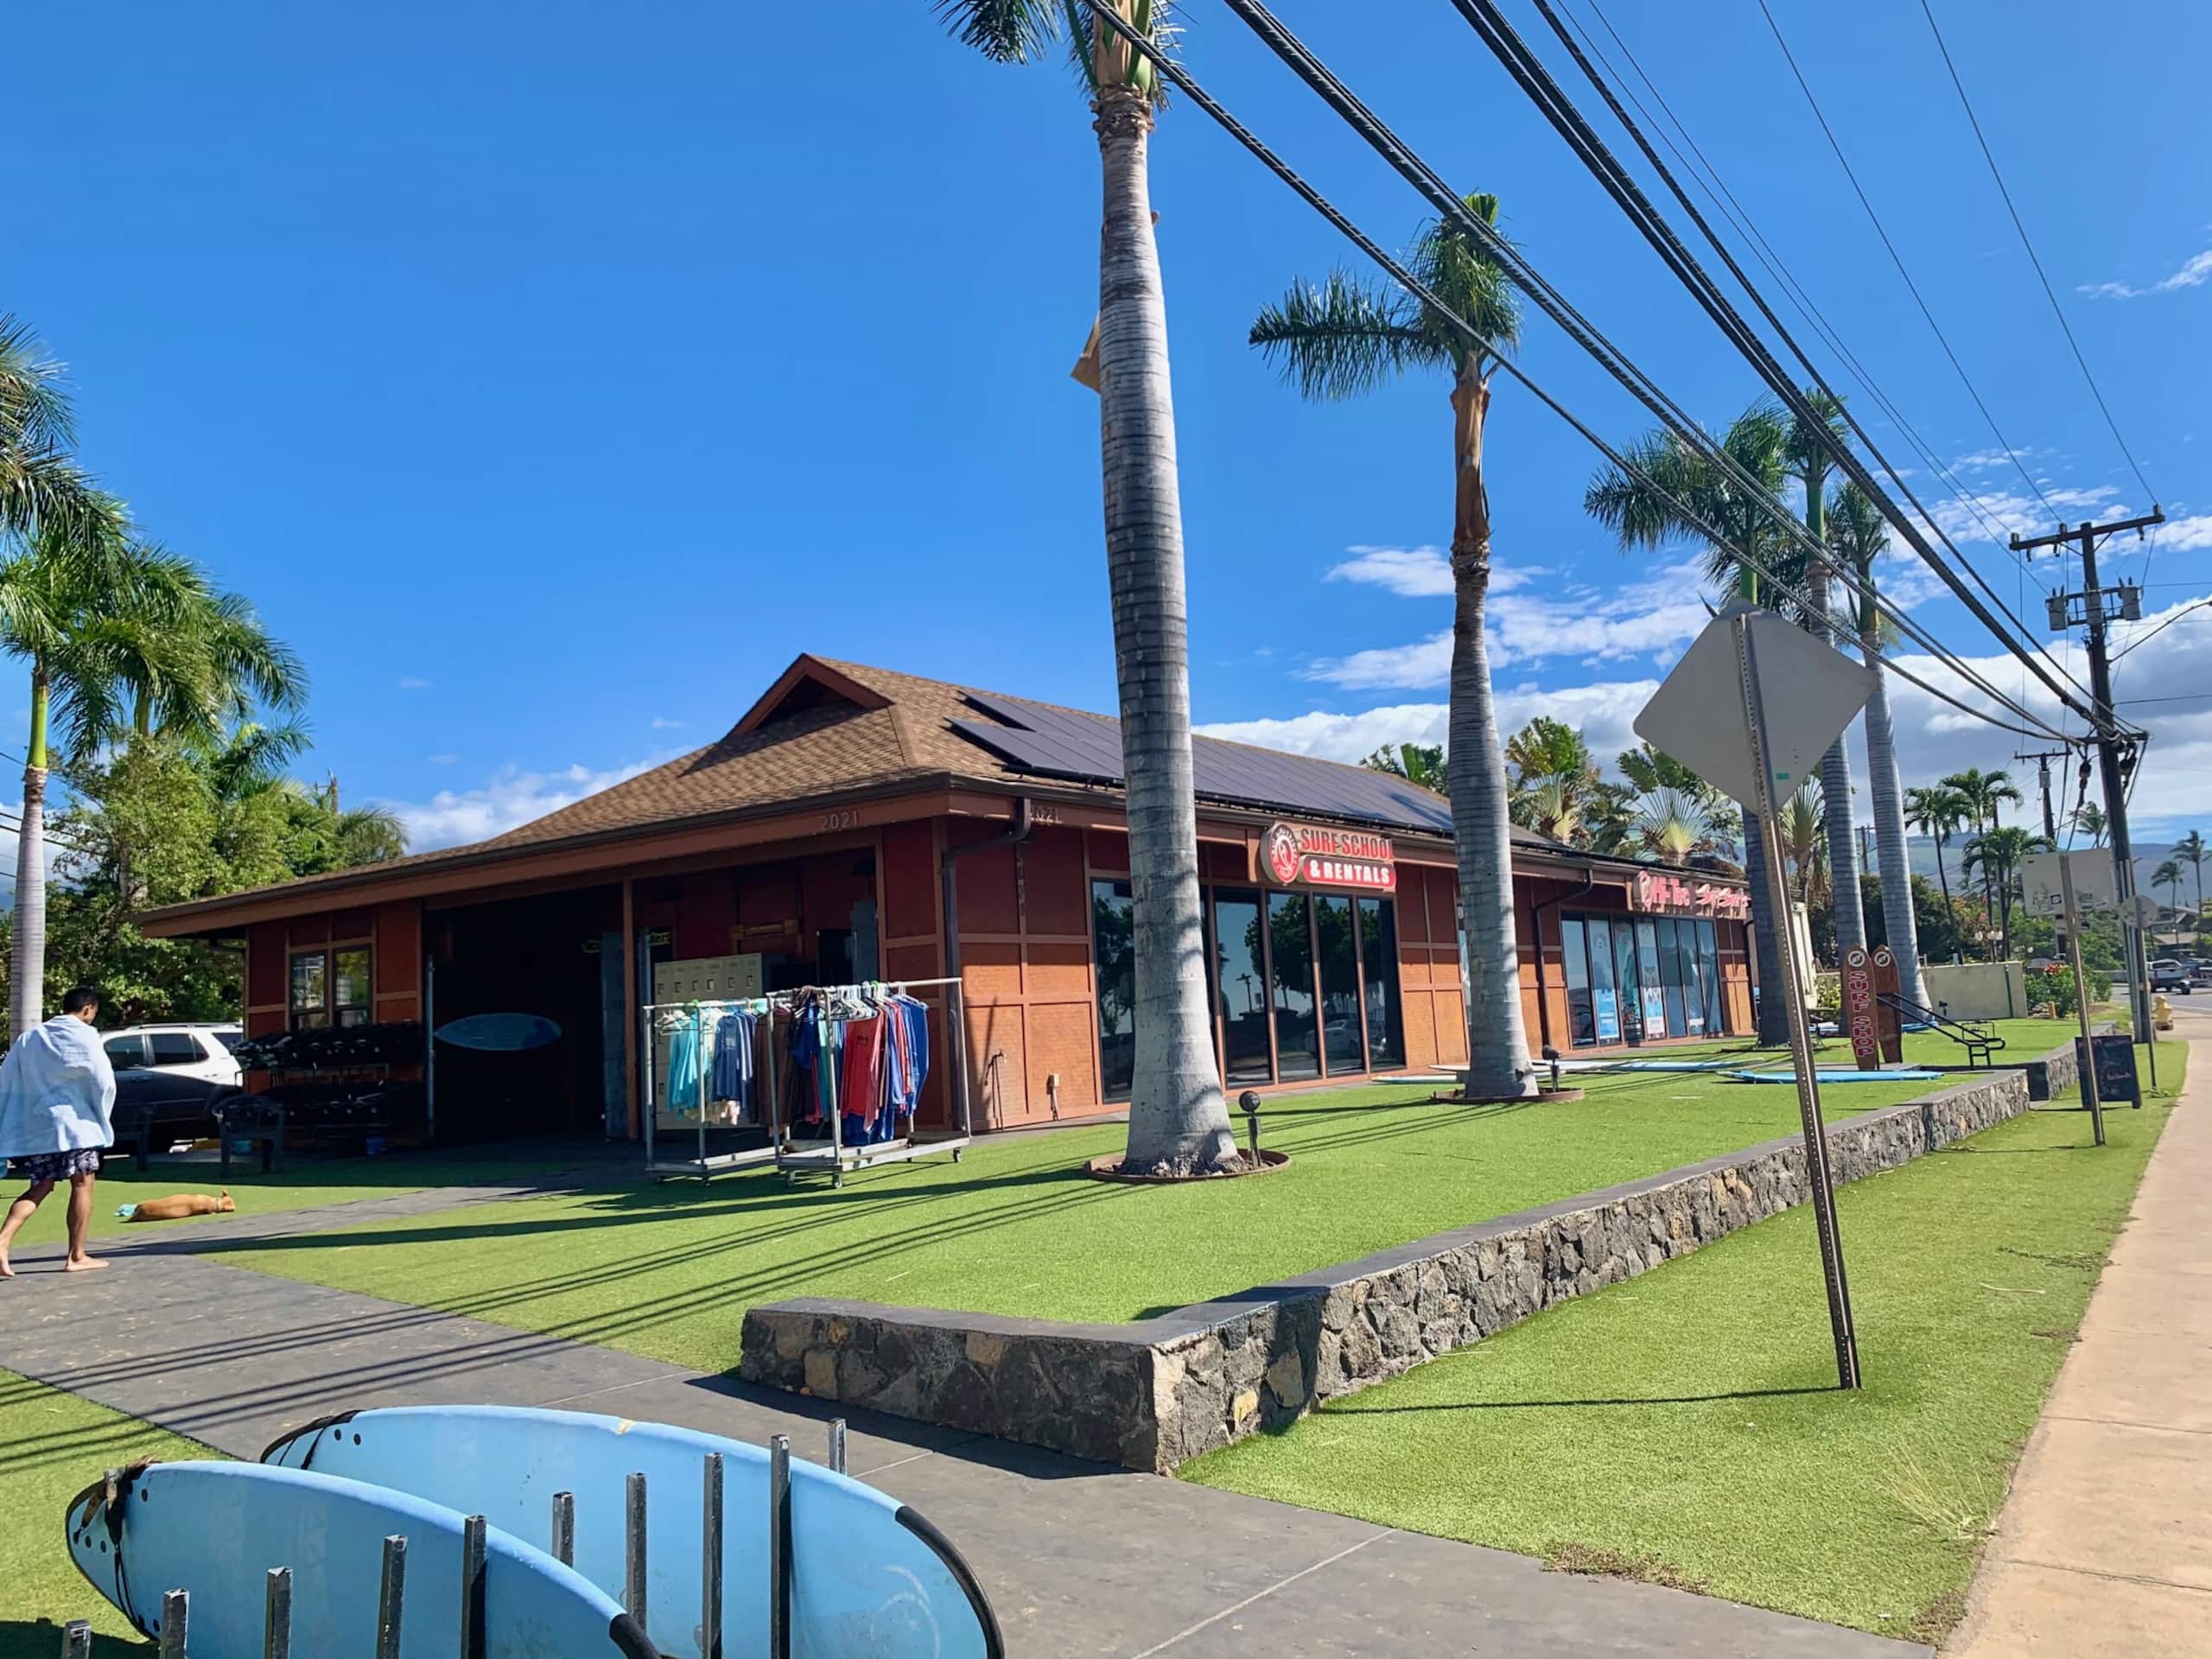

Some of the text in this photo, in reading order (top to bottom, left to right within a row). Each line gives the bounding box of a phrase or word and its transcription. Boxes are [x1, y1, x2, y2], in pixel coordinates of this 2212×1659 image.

[822, 810, 857, 830] 2021
[1300, 828, 1338, 853] SURF
[1341, 834, 1395, 860] SCHOOL
[1310, 860, 1390, 884] & RENTALS
[1848, 969, 1875, 1058] SURF SHOP
